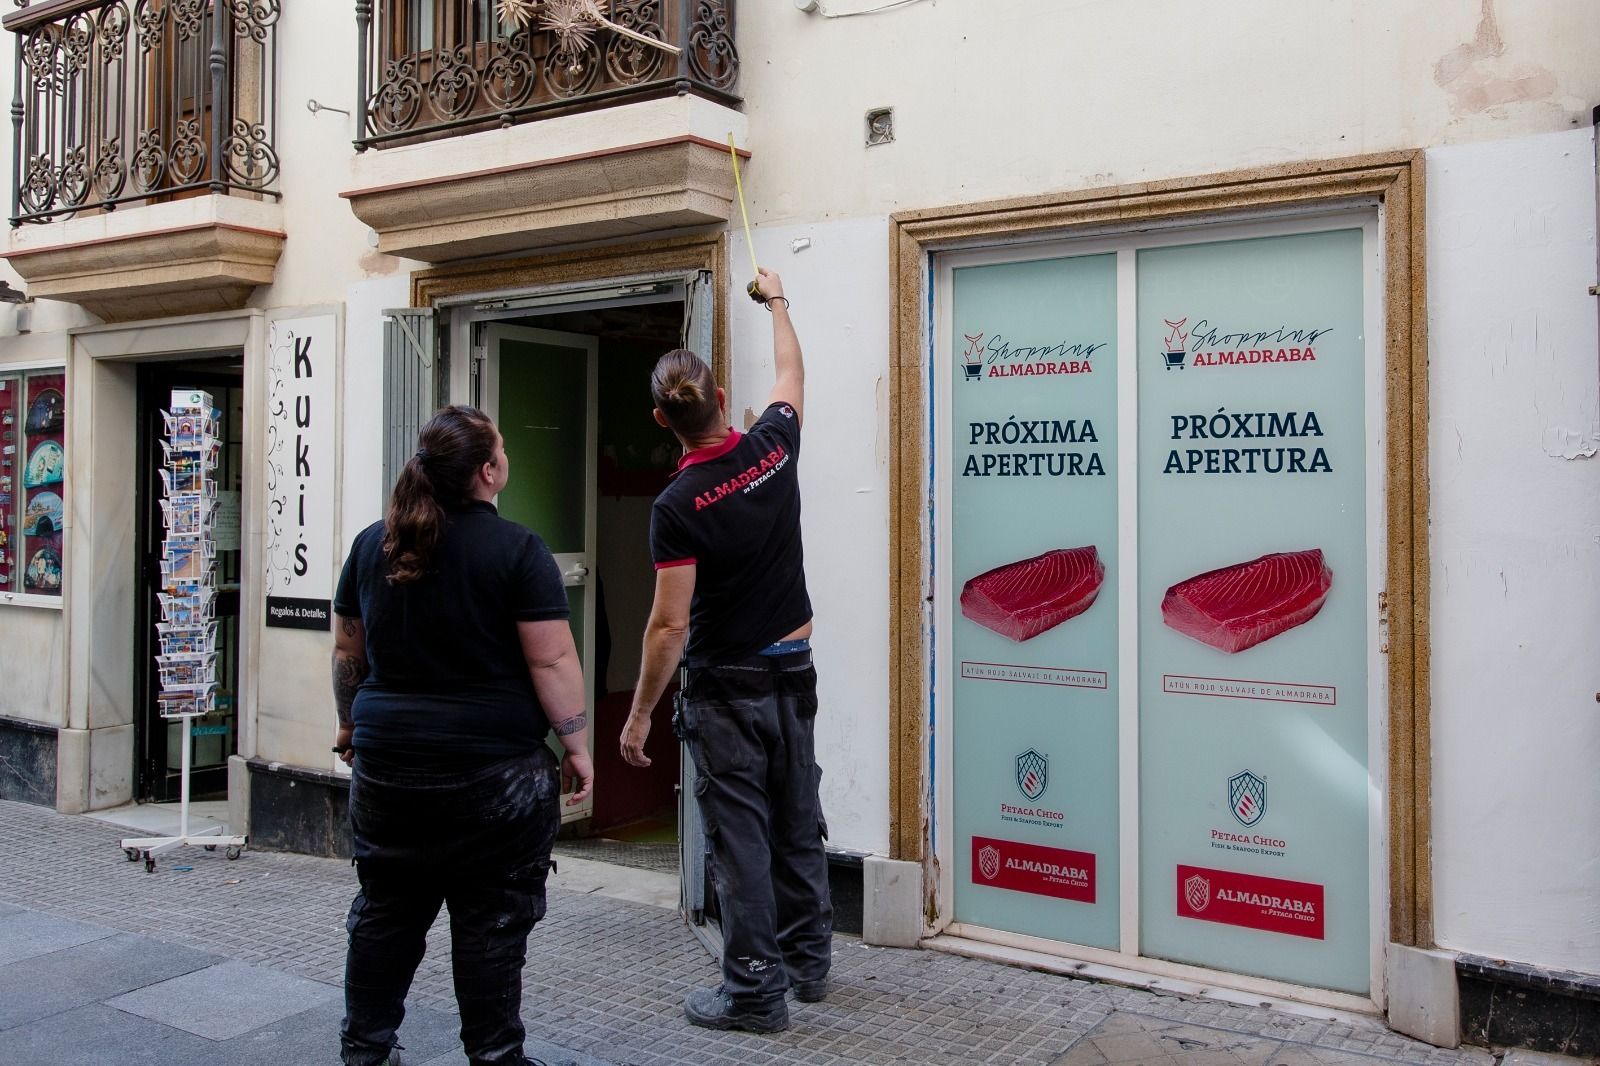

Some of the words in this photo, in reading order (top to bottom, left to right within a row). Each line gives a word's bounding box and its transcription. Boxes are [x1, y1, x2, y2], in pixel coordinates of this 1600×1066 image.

[1191, 319, 1333, 352] Shopping
[987, 334, 1107, 364] Shopping
[1193, 347, 1317, 367] ALMADRABA
[988, 360, 1093, 378] ALMADRABA
[969, 415, 1099, 445] PRÓXIMA
[1171, 407, 1324, 440] PRÓXIMA
[962, 453, 1106, 477] APERTURA
[1163, 447, 1333, 474] APERTURA
[693, 442, 785, 511] ALMADRABA
[270, 606, 294, 618] Regalos
[294, 608, 301, 617] &
[301, 608, 327, 619] Detalles
[1043, 673, 1053, 681] DE
[1056, 674, 1103, 684] ALMADRABA
[1168, 680, 1190, 689] ATÚN
[1194, 683, 1215, 691] ROJO
[1219, 685, 1257, 695] SALVAJE
[1260, 688, 1271, 696] DE
[1275, 689, 1331, 700] ALMADRABA
[1005, 857, 1089, 880] ALMADRABA
[1216, 888, 1315, 914] ALMADRABA
